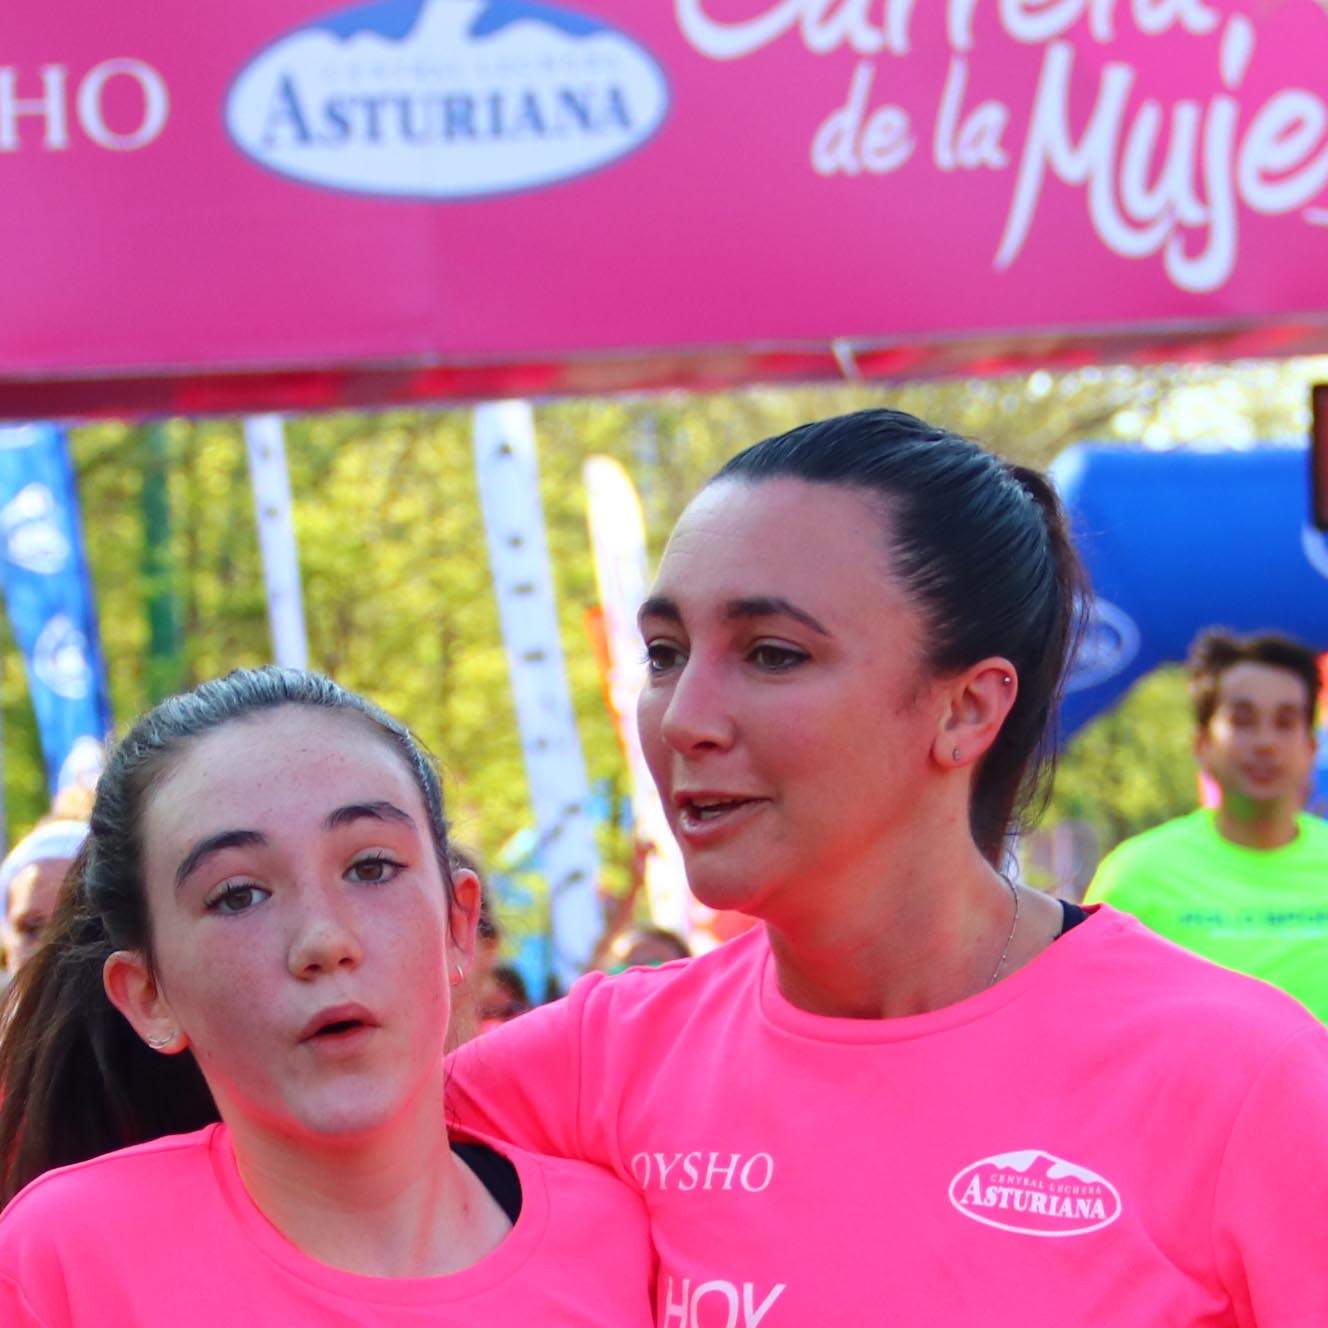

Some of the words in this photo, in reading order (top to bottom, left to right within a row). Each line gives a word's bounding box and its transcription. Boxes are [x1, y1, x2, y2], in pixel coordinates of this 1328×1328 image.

[259, 64, 635, 150] ASTURIANA
[810, 60, 914, 176] de
[932, 55, 1008, 170] la
[630, 1151, 774, 1192] OYSHO
[959, 1173, 1106, 1220] ASTURIANA
